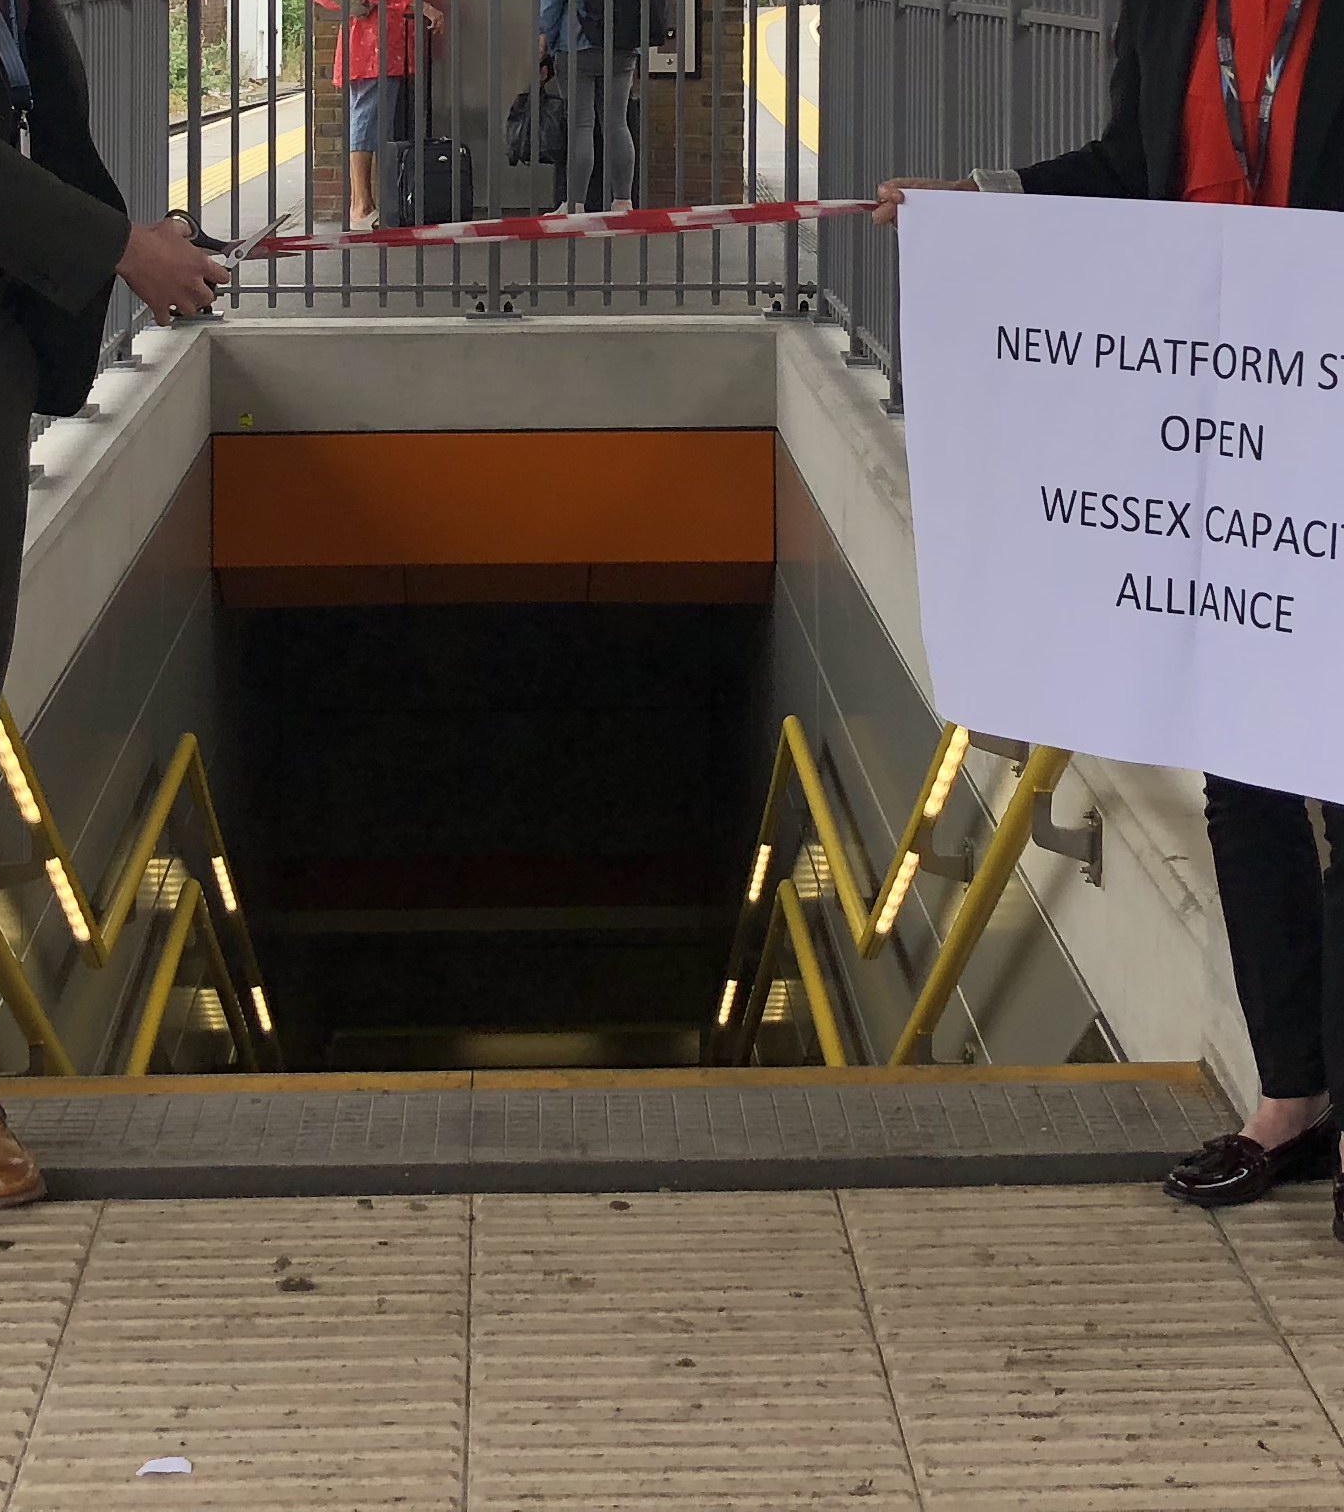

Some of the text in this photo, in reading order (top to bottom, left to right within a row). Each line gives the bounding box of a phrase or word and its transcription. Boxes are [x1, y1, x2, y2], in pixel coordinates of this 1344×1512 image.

[997, 324, 1083, 366] NEW
[1095, 333, 1305, 388] PLATFORM
[1159, 414, 1265, 461] OPEN
[1040, 485, 1192, 540] WESSEX
[1115, 572, 1296, 634] ALLIANCE
